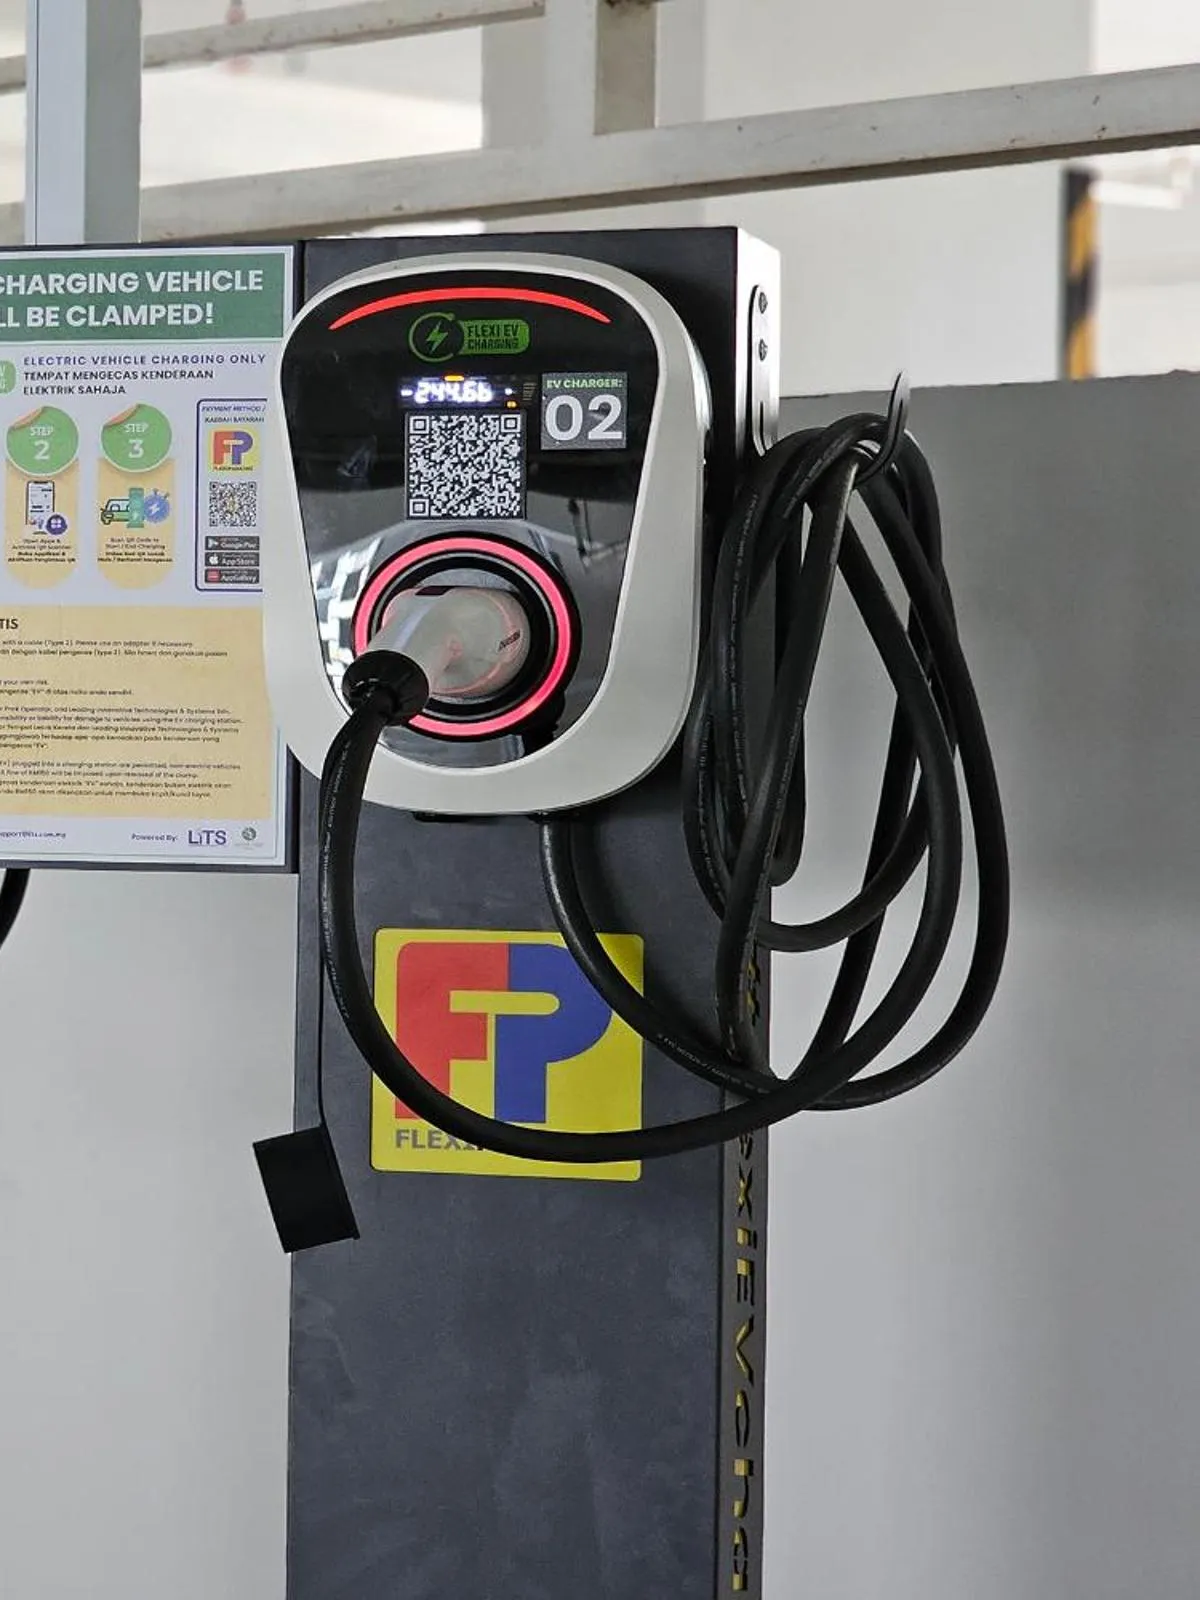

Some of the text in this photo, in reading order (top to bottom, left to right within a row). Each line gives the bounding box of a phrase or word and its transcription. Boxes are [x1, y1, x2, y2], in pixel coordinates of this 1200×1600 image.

[145, 269, 263, 293] VEHICLE
[26, 306, 60, 328] BE
[65, 302, 214, 328] CLAMPED!
[467, 324, 519, 337] FLEXI EV
[467, 339, 519, 350] CHARGING
[23, 354, 266, 366] ELECTRIC VEHICLE CHARGING ONLY
[23, 370, 214, 381] TEMPAT MENGECAS KENDERAAN
[546, 378, 623, 389] EV CHARGER:
[23, 385, 127, 396] ELEKTRIK SAHAJA
[544, 393, 623, 441] 02
[30, 426, 54, 437] STEP
[124, 423, 148, 433] STEP
[34, 441, 51, 461] 2
[128, 438, 144, 459] 3
[131, 833, 165, 841] Powered
[166, 833, 178, 842] By:
